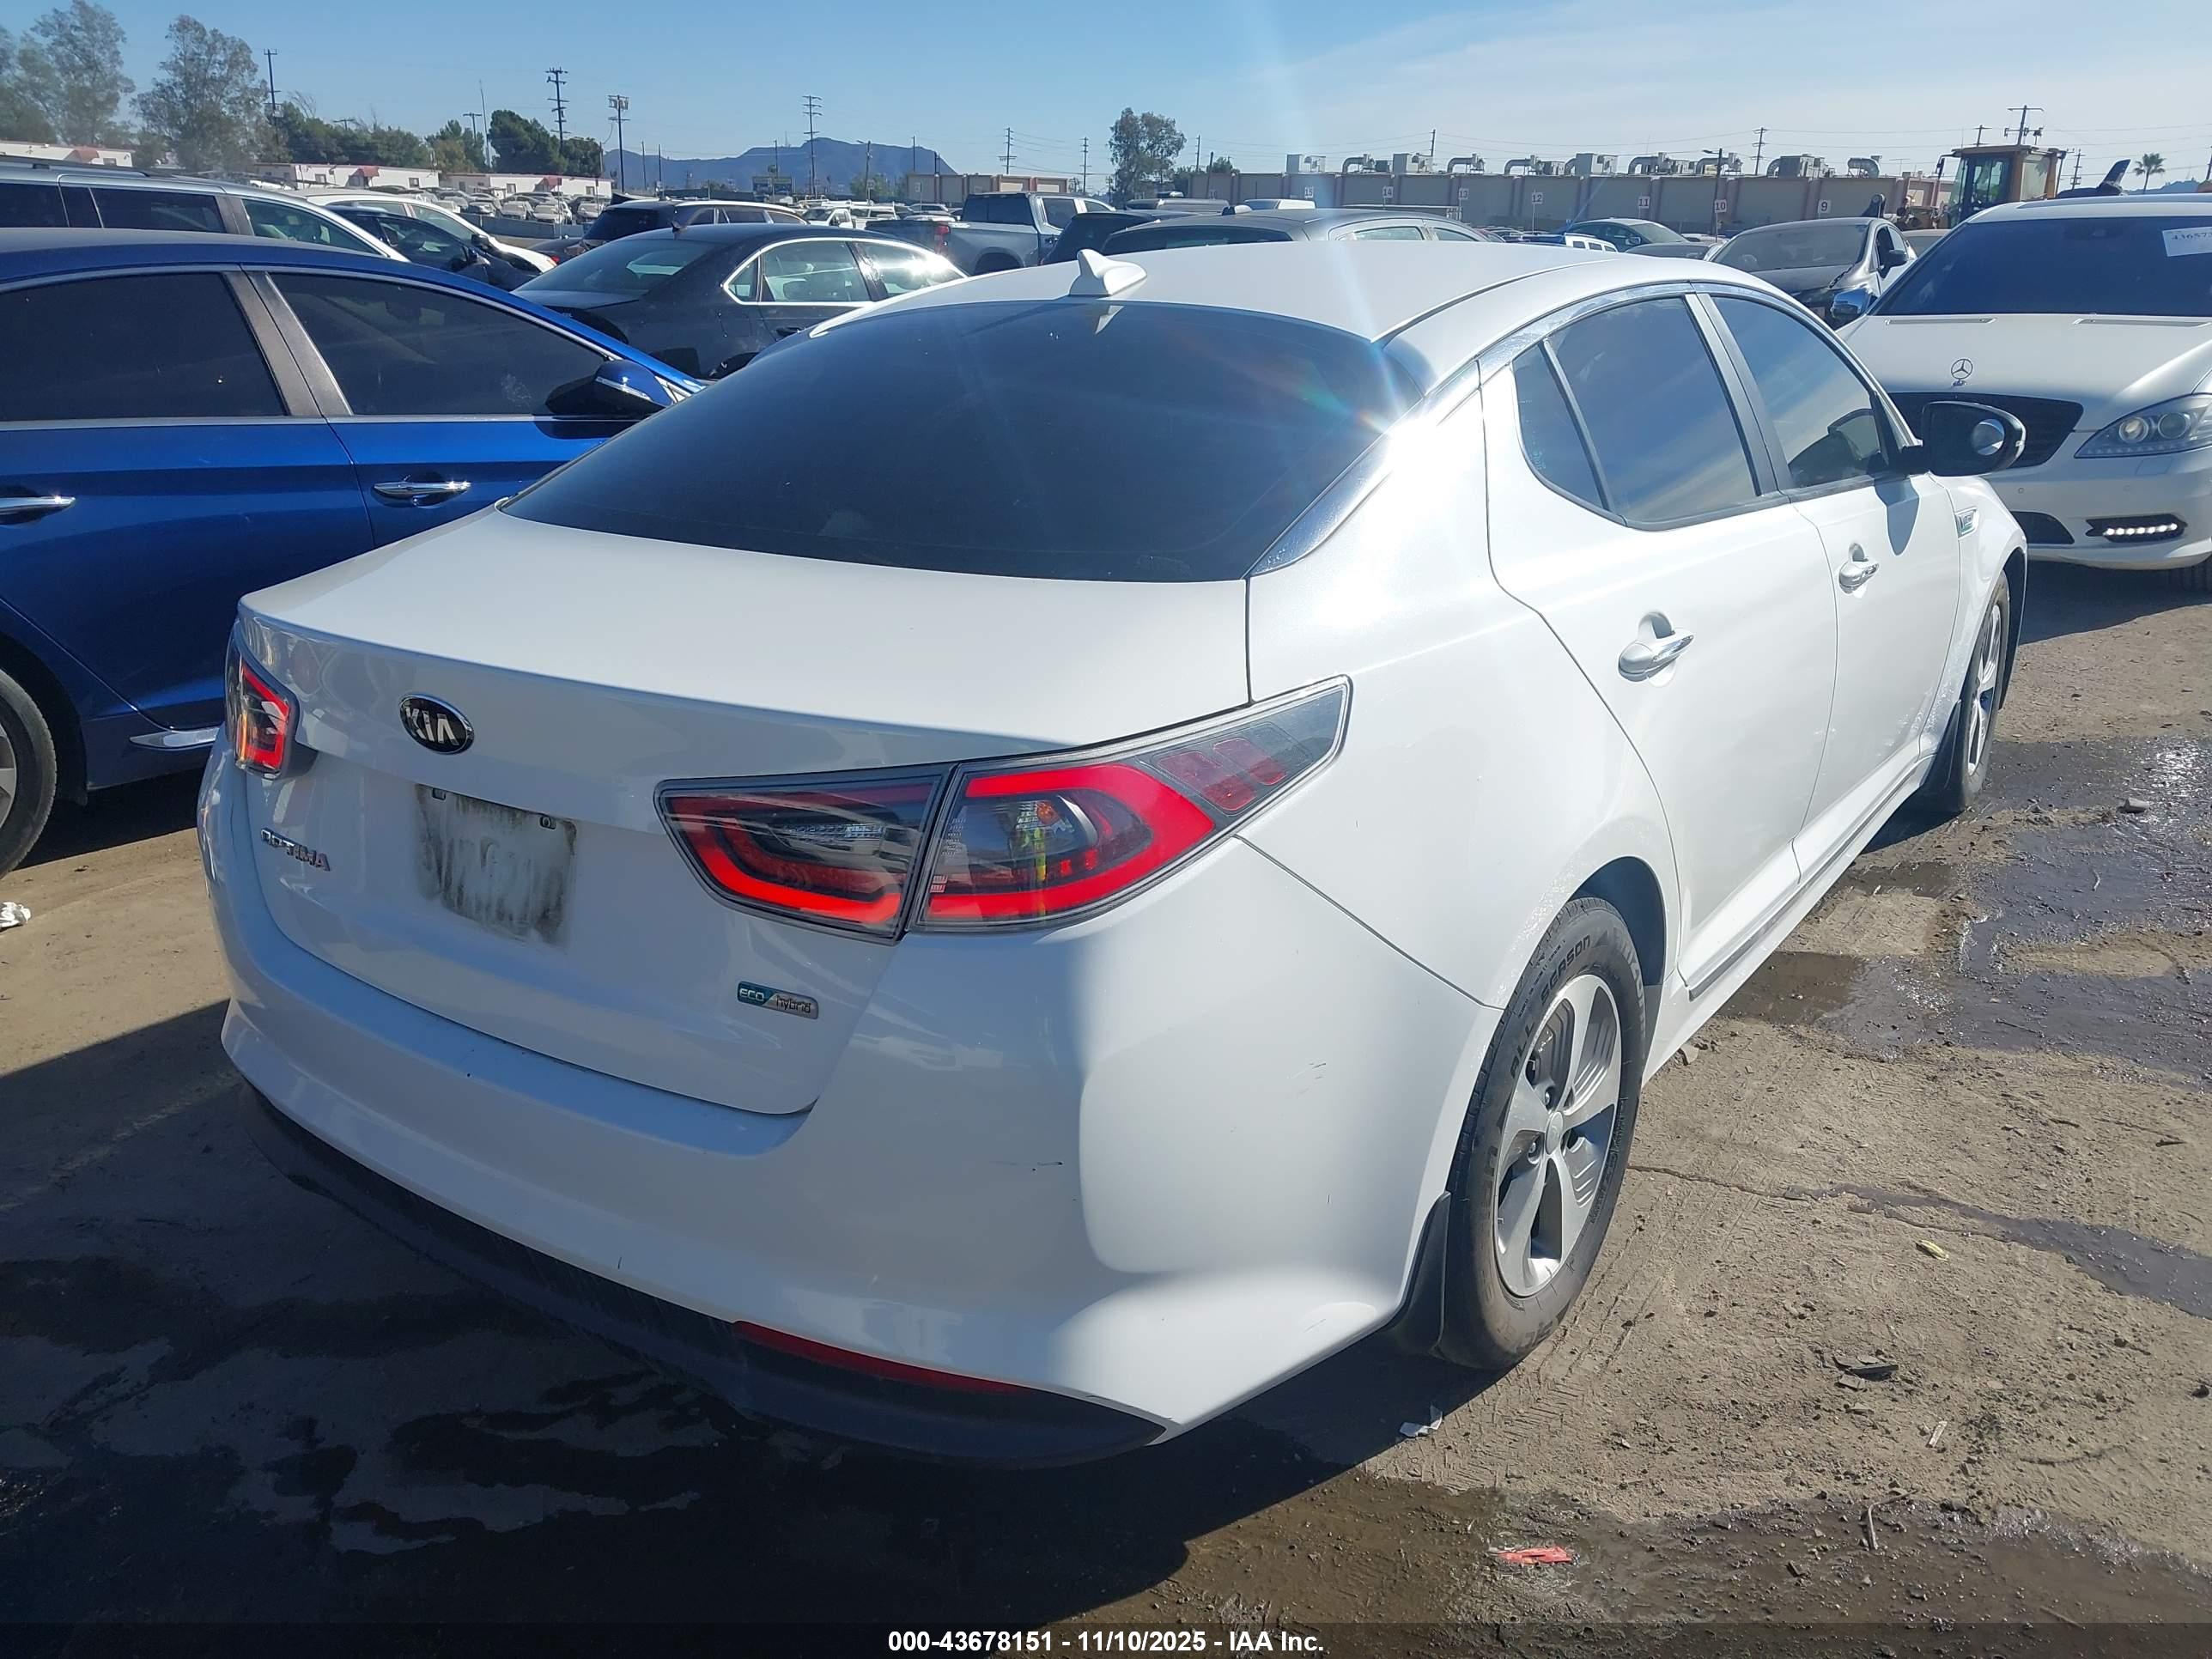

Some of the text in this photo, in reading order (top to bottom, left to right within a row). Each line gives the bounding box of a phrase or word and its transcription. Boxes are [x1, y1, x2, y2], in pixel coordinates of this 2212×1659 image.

[1305, 187, 1314, 197] 15
[1383, 188, 1393, 197] 14
[1532, 194, 1542, 203] 12
[1638, 198, 1649, 207] 11
[1715, 202, 1726, 210] 10
[1820, 201, 1828, 211] 9
[404, 706, 460, 746] KIA
[261, 828, 331, 872] OPTIMA
[739, 988, 811, 1014] ECO hybrid
